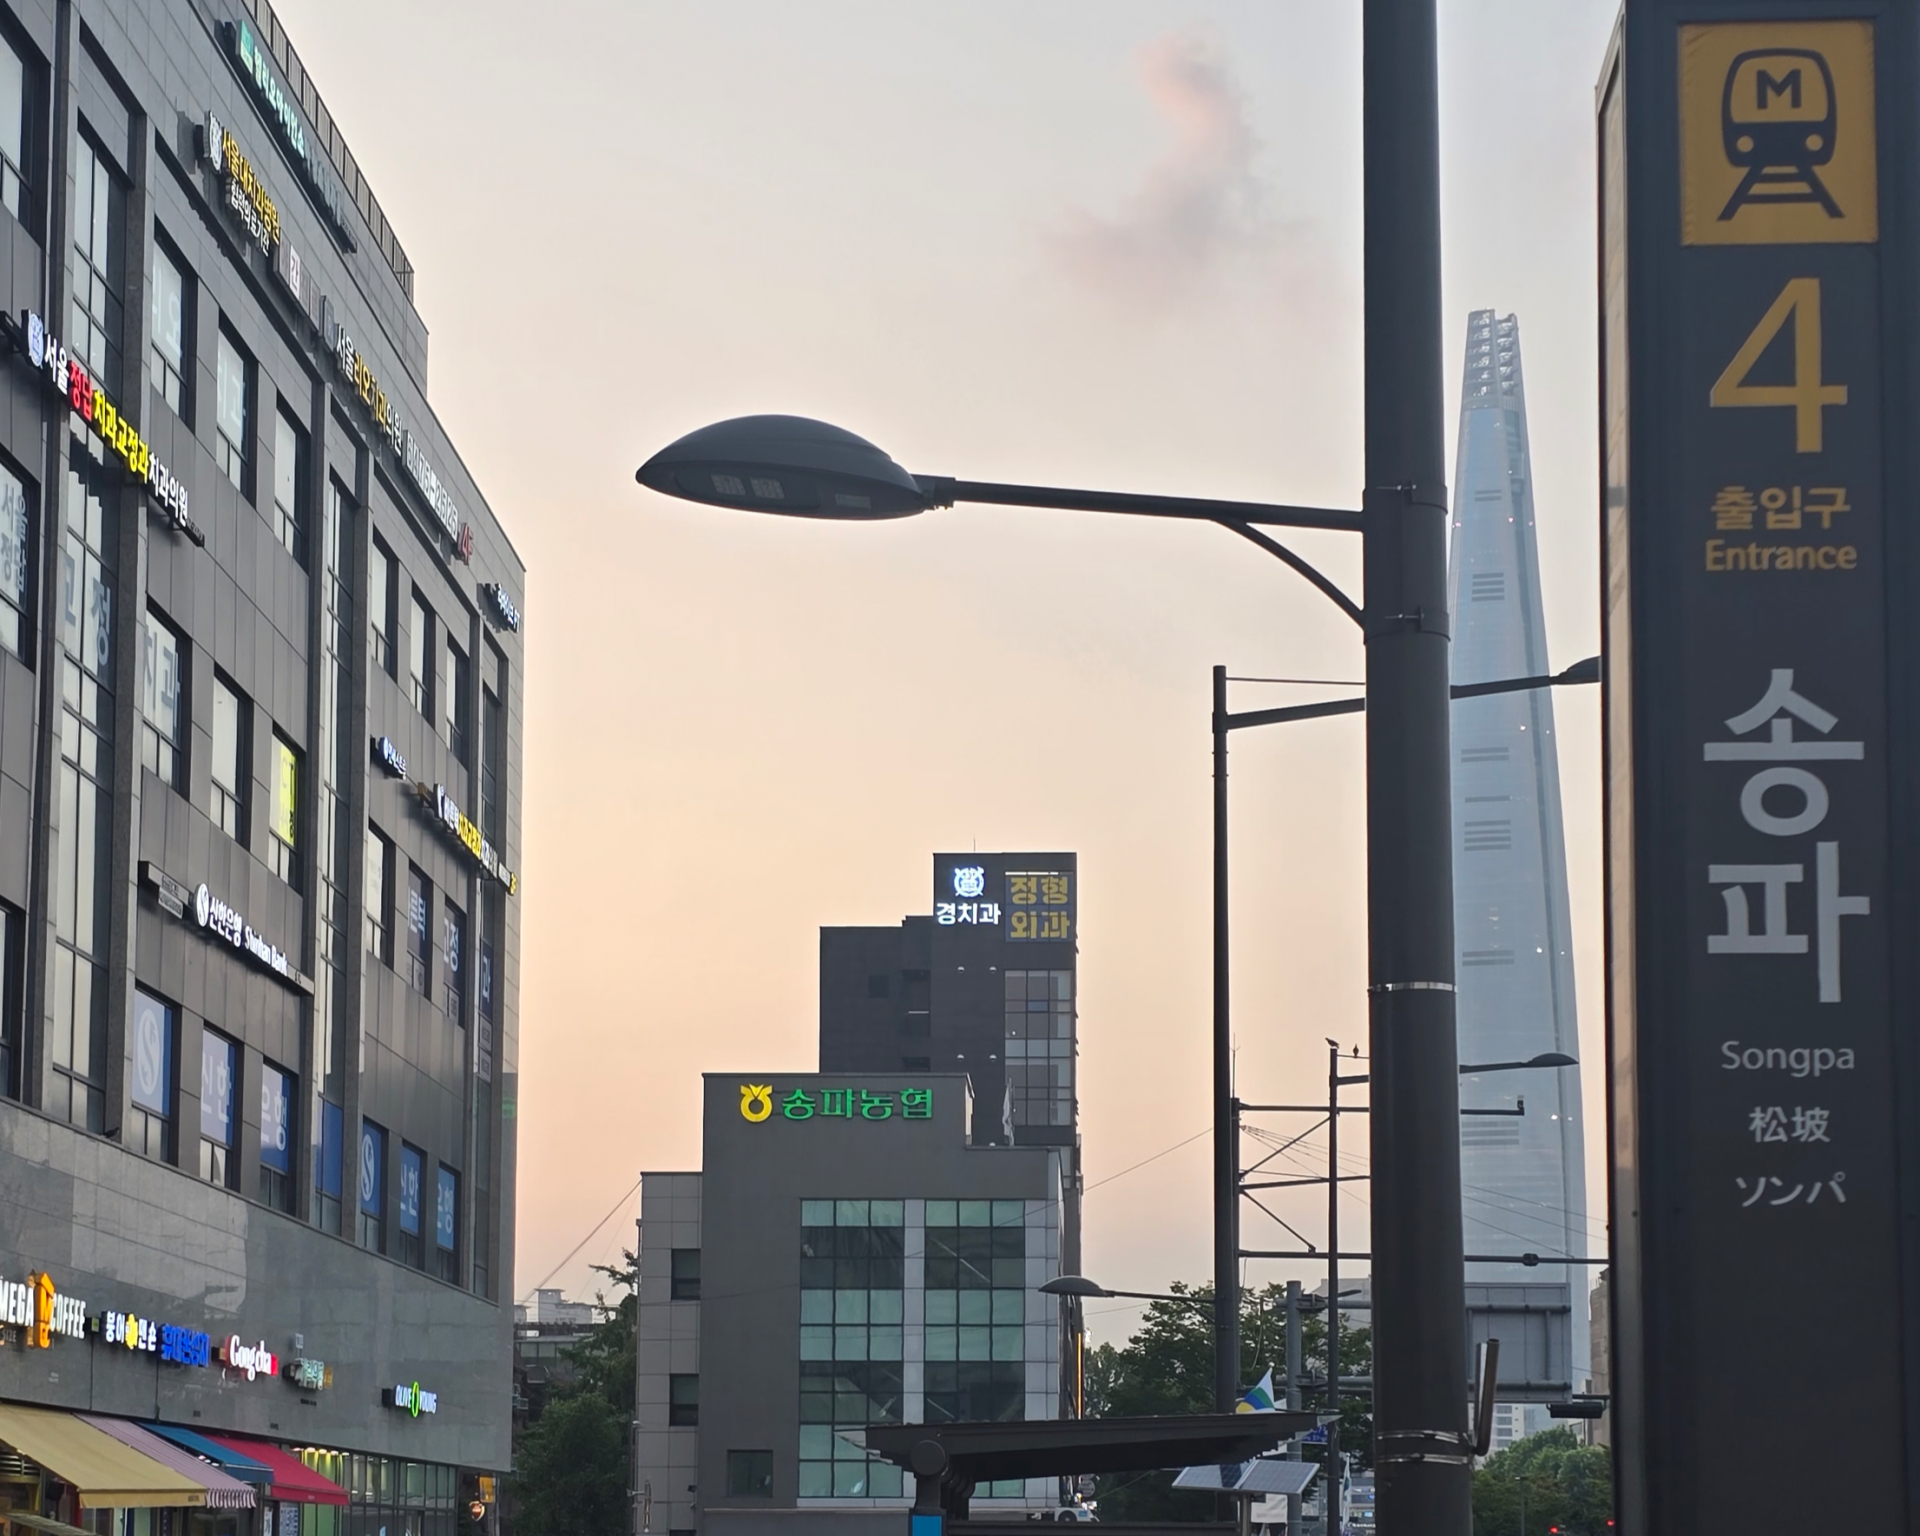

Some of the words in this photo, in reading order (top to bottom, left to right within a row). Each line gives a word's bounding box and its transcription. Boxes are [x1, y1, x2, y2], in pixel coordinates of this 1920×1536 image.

[1756, 69, 1802, 109] M
[222, 127, 281, 246] 서울대치과병원
[231, 178, 270, 258] 협력의료기관
[1709, 277, 1847, 453] 4
[336, 323, 403, 458] 서울리오치과의원
[44, 333, 188, 528] 서울정답치과교정과치과의원
[1710, 486, 1851, 531] 출입구
[1706, 539, 1858, 571] Entrance
[1703, 668, 1870, 1003] 송파
[1010, 876, 1069, 904] 정형
[936, 902, 1002, 925] 경치과
[1010, 911, 1071, 939] 외과
[209, 896, 243, 948] 신한은행
[244, 926, 271, 965] Shinhan
[271, 945, 287, 977] Bank
[1720, 1041, 1855, 1077] Songpa
[782, 1088, 933, 1120] 송파농협
[1749, 1106, 1831, 1144] 松坡
[1735, 1171, 1847, 1207] ソンパ
[0, 1279, 34, 1328] MEGA
[51, 1292, 87, 1339] COFFEE
[161, 1323, 210, 1368] 휴대폰성지
[395, 1384, 412, 1409] OLIVE
[419, 1390, 438, 1414] YOUNG
